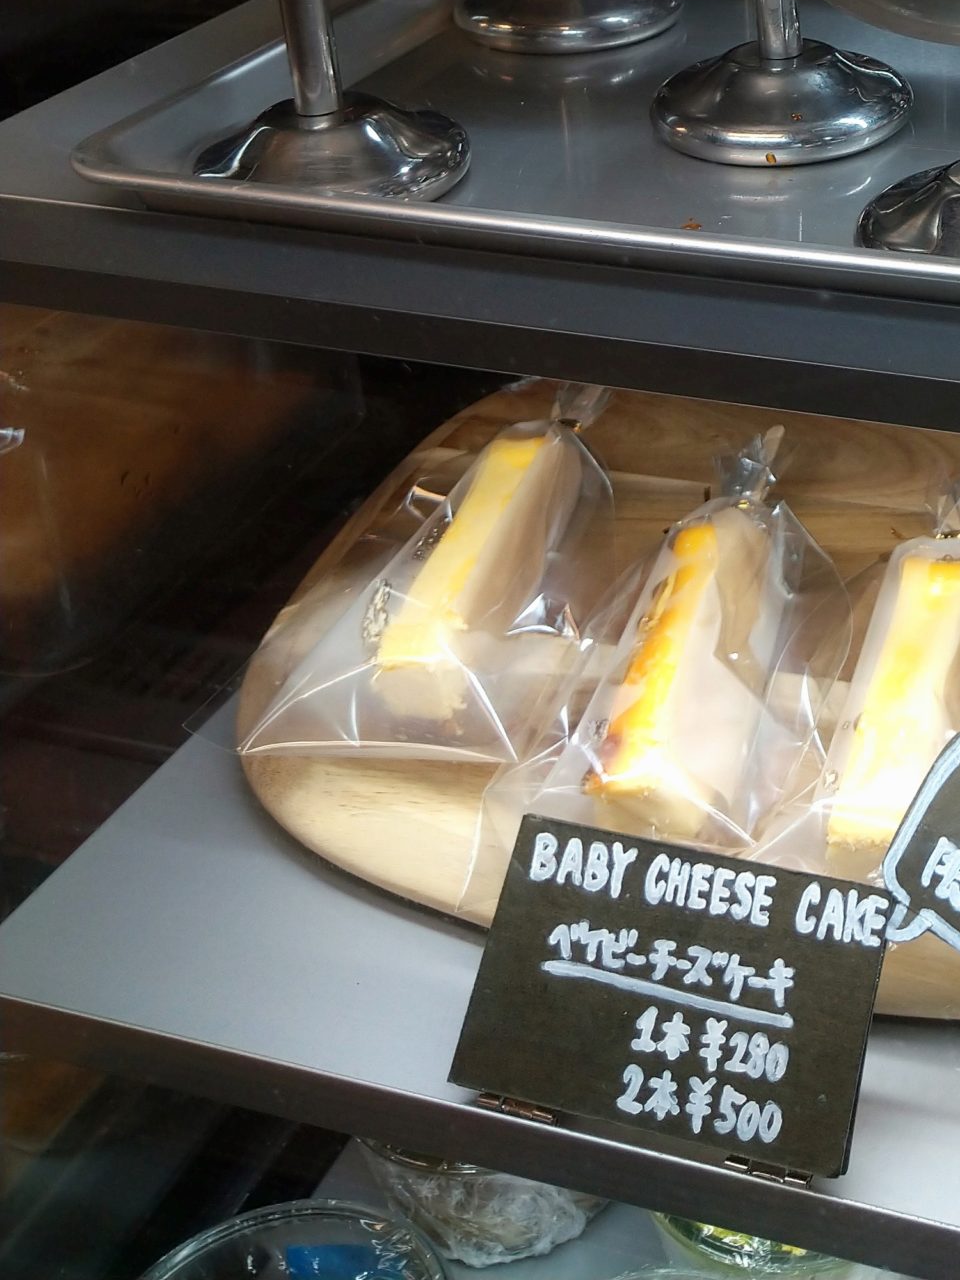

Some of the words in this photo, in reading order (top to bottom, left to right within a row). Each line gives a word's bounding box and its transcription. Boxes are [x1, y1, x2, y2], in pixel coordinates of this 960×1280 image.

[528, 832, 639, 899] BABY
[644, 853, 777, 928] CHEESE
[795, 881, 890, 948] CAKE
[547, 918, 796, 1008] ベイビーチーズケーキ
[699, 1016, 790, 1083] ¥280
[684, 1074, 784, 1144] ¥500
